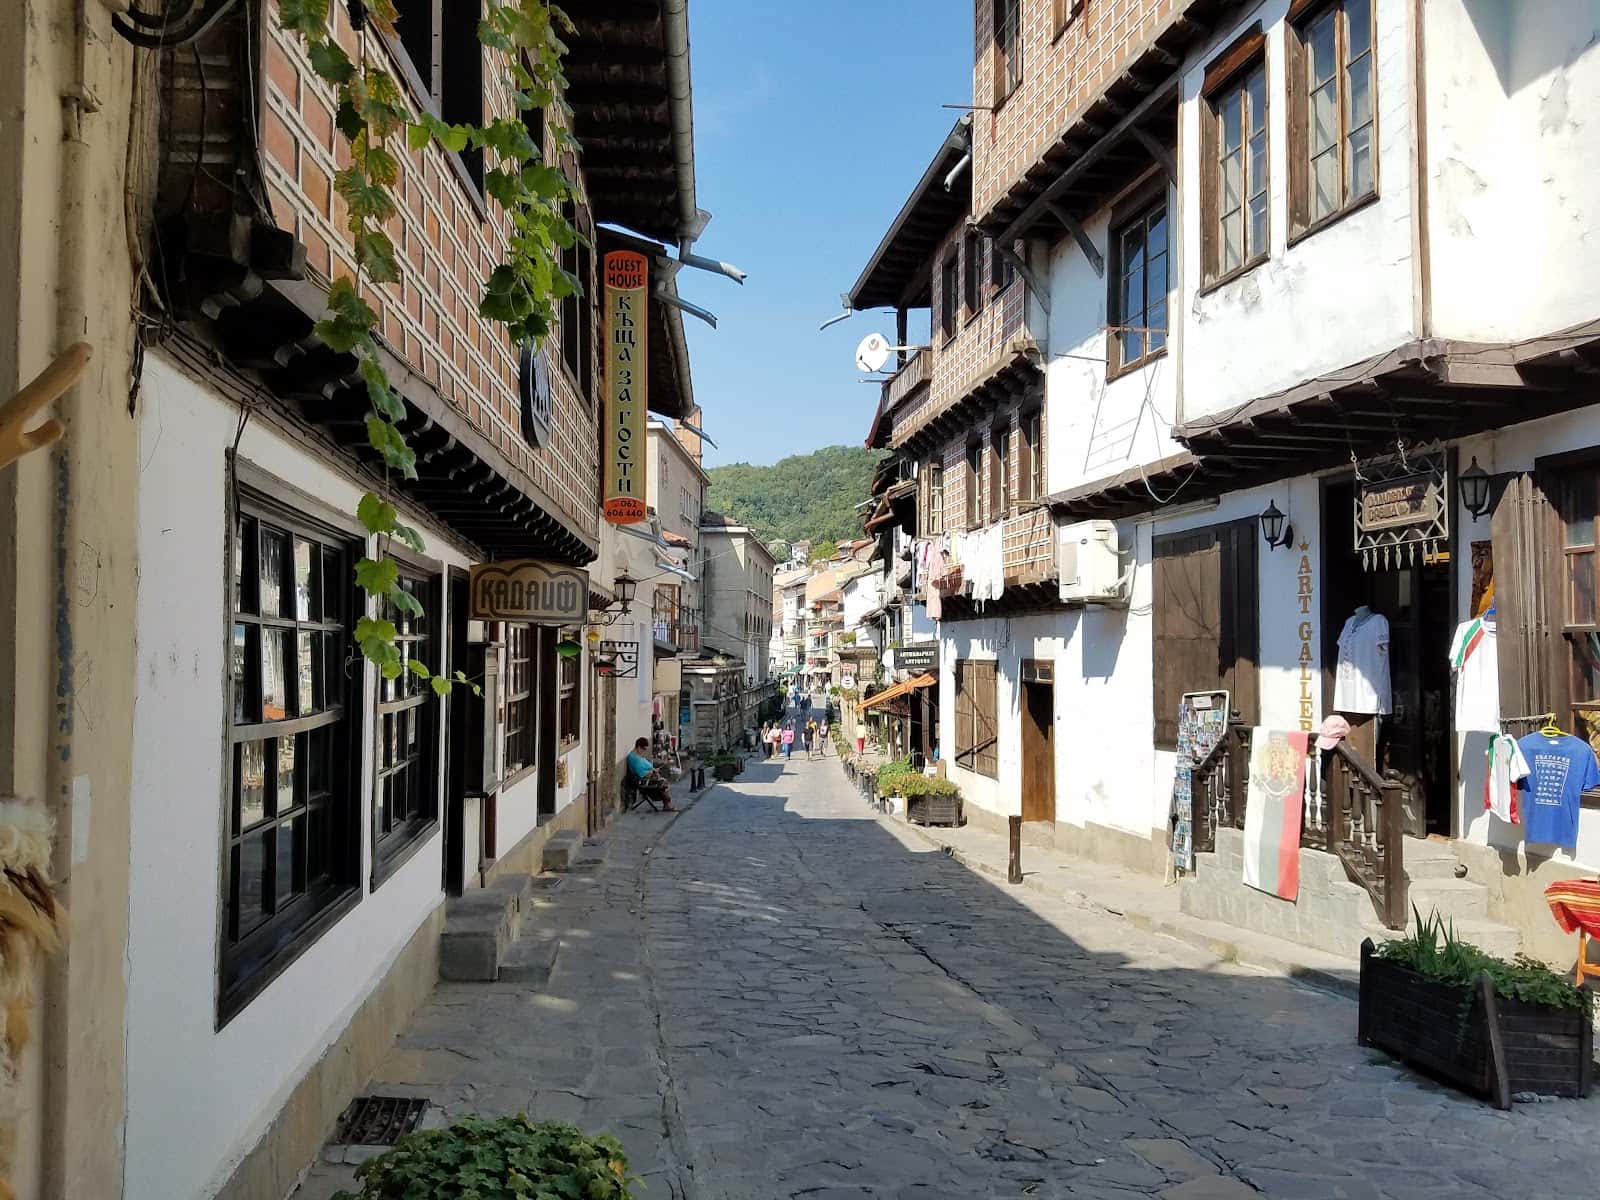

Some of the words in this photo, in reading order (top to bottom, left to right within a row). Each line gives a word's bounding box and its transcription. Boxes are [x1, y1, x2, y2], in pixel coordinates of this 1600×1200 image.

[608, 258, 642, 272] GUEST
[608, 273, 643, 288] HOUSE
[615, 296, 636, 361] КЪЩА
[617, 370, 632, 401] ЗА
[616, 411, 634, 492] ГОСТИ
[481, 578, 577, 613] КАДАИФ
[1297, 555, 1313, 614] ART
